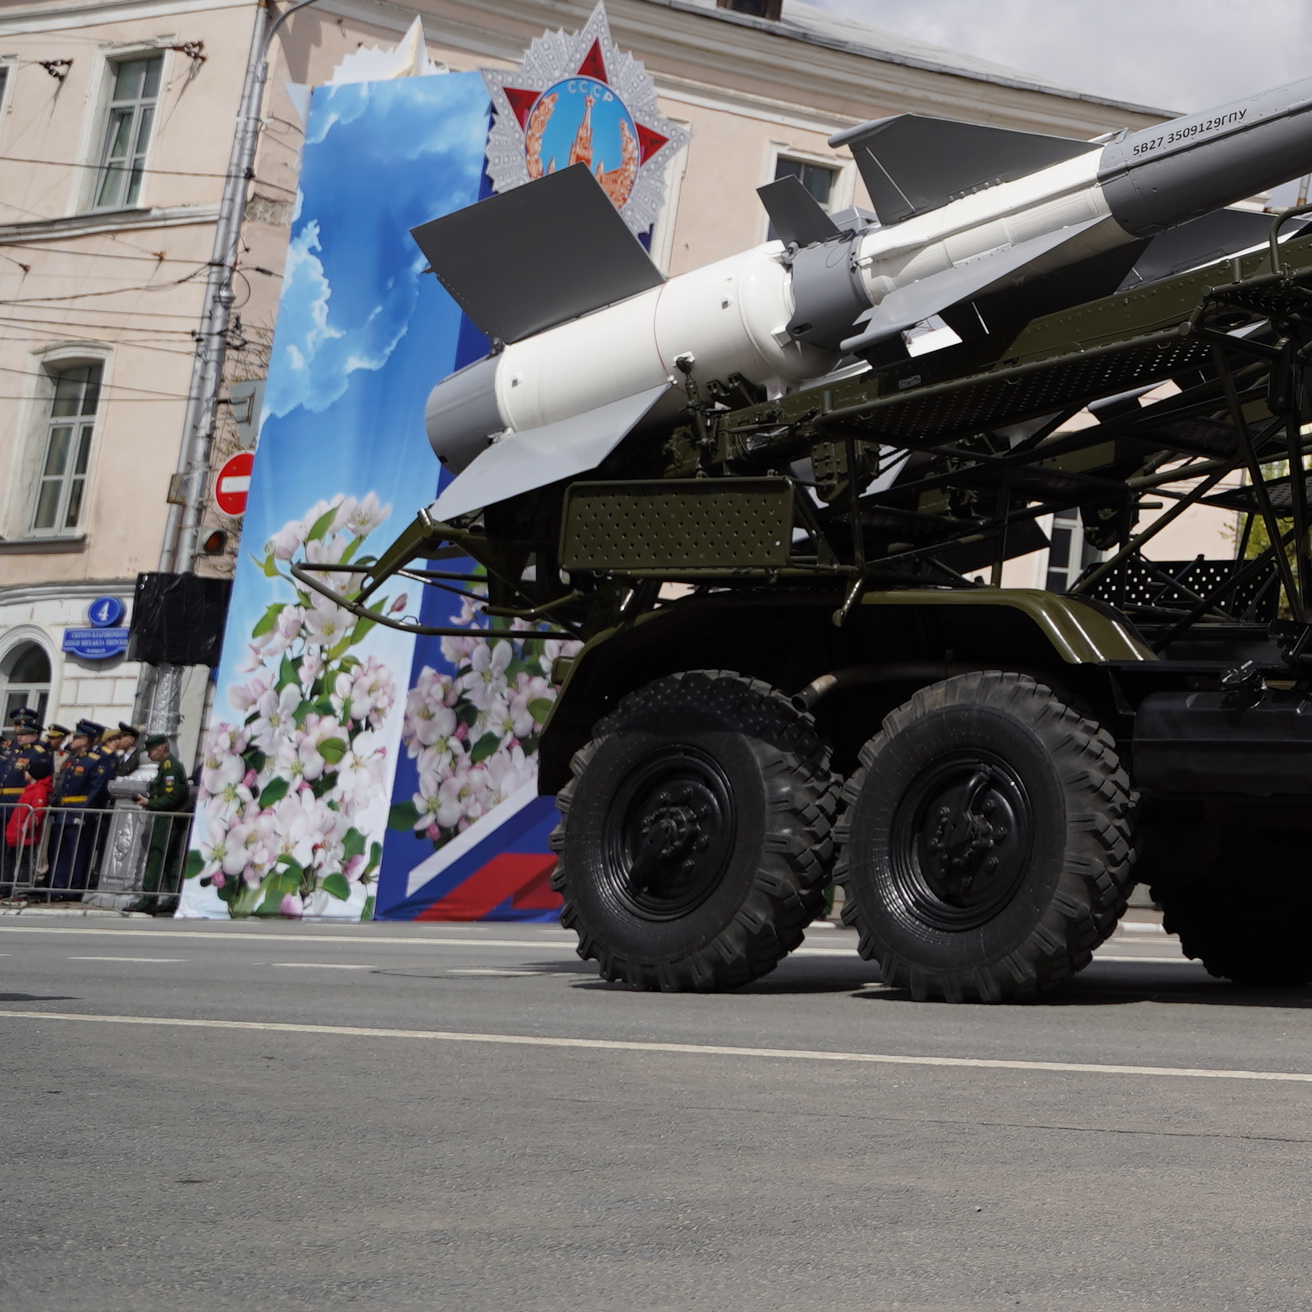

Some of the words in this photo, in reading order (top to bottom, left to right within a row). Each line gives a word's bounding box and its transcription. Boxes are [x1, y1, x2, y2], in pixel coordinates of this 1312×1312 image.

[567, 80, 614, 102] СССР
[1133, 137, 1164, 156] 5В27
[1167, 109, 1247, 144] 3509129ГПУ
[98, 601, 109, 621] 4
